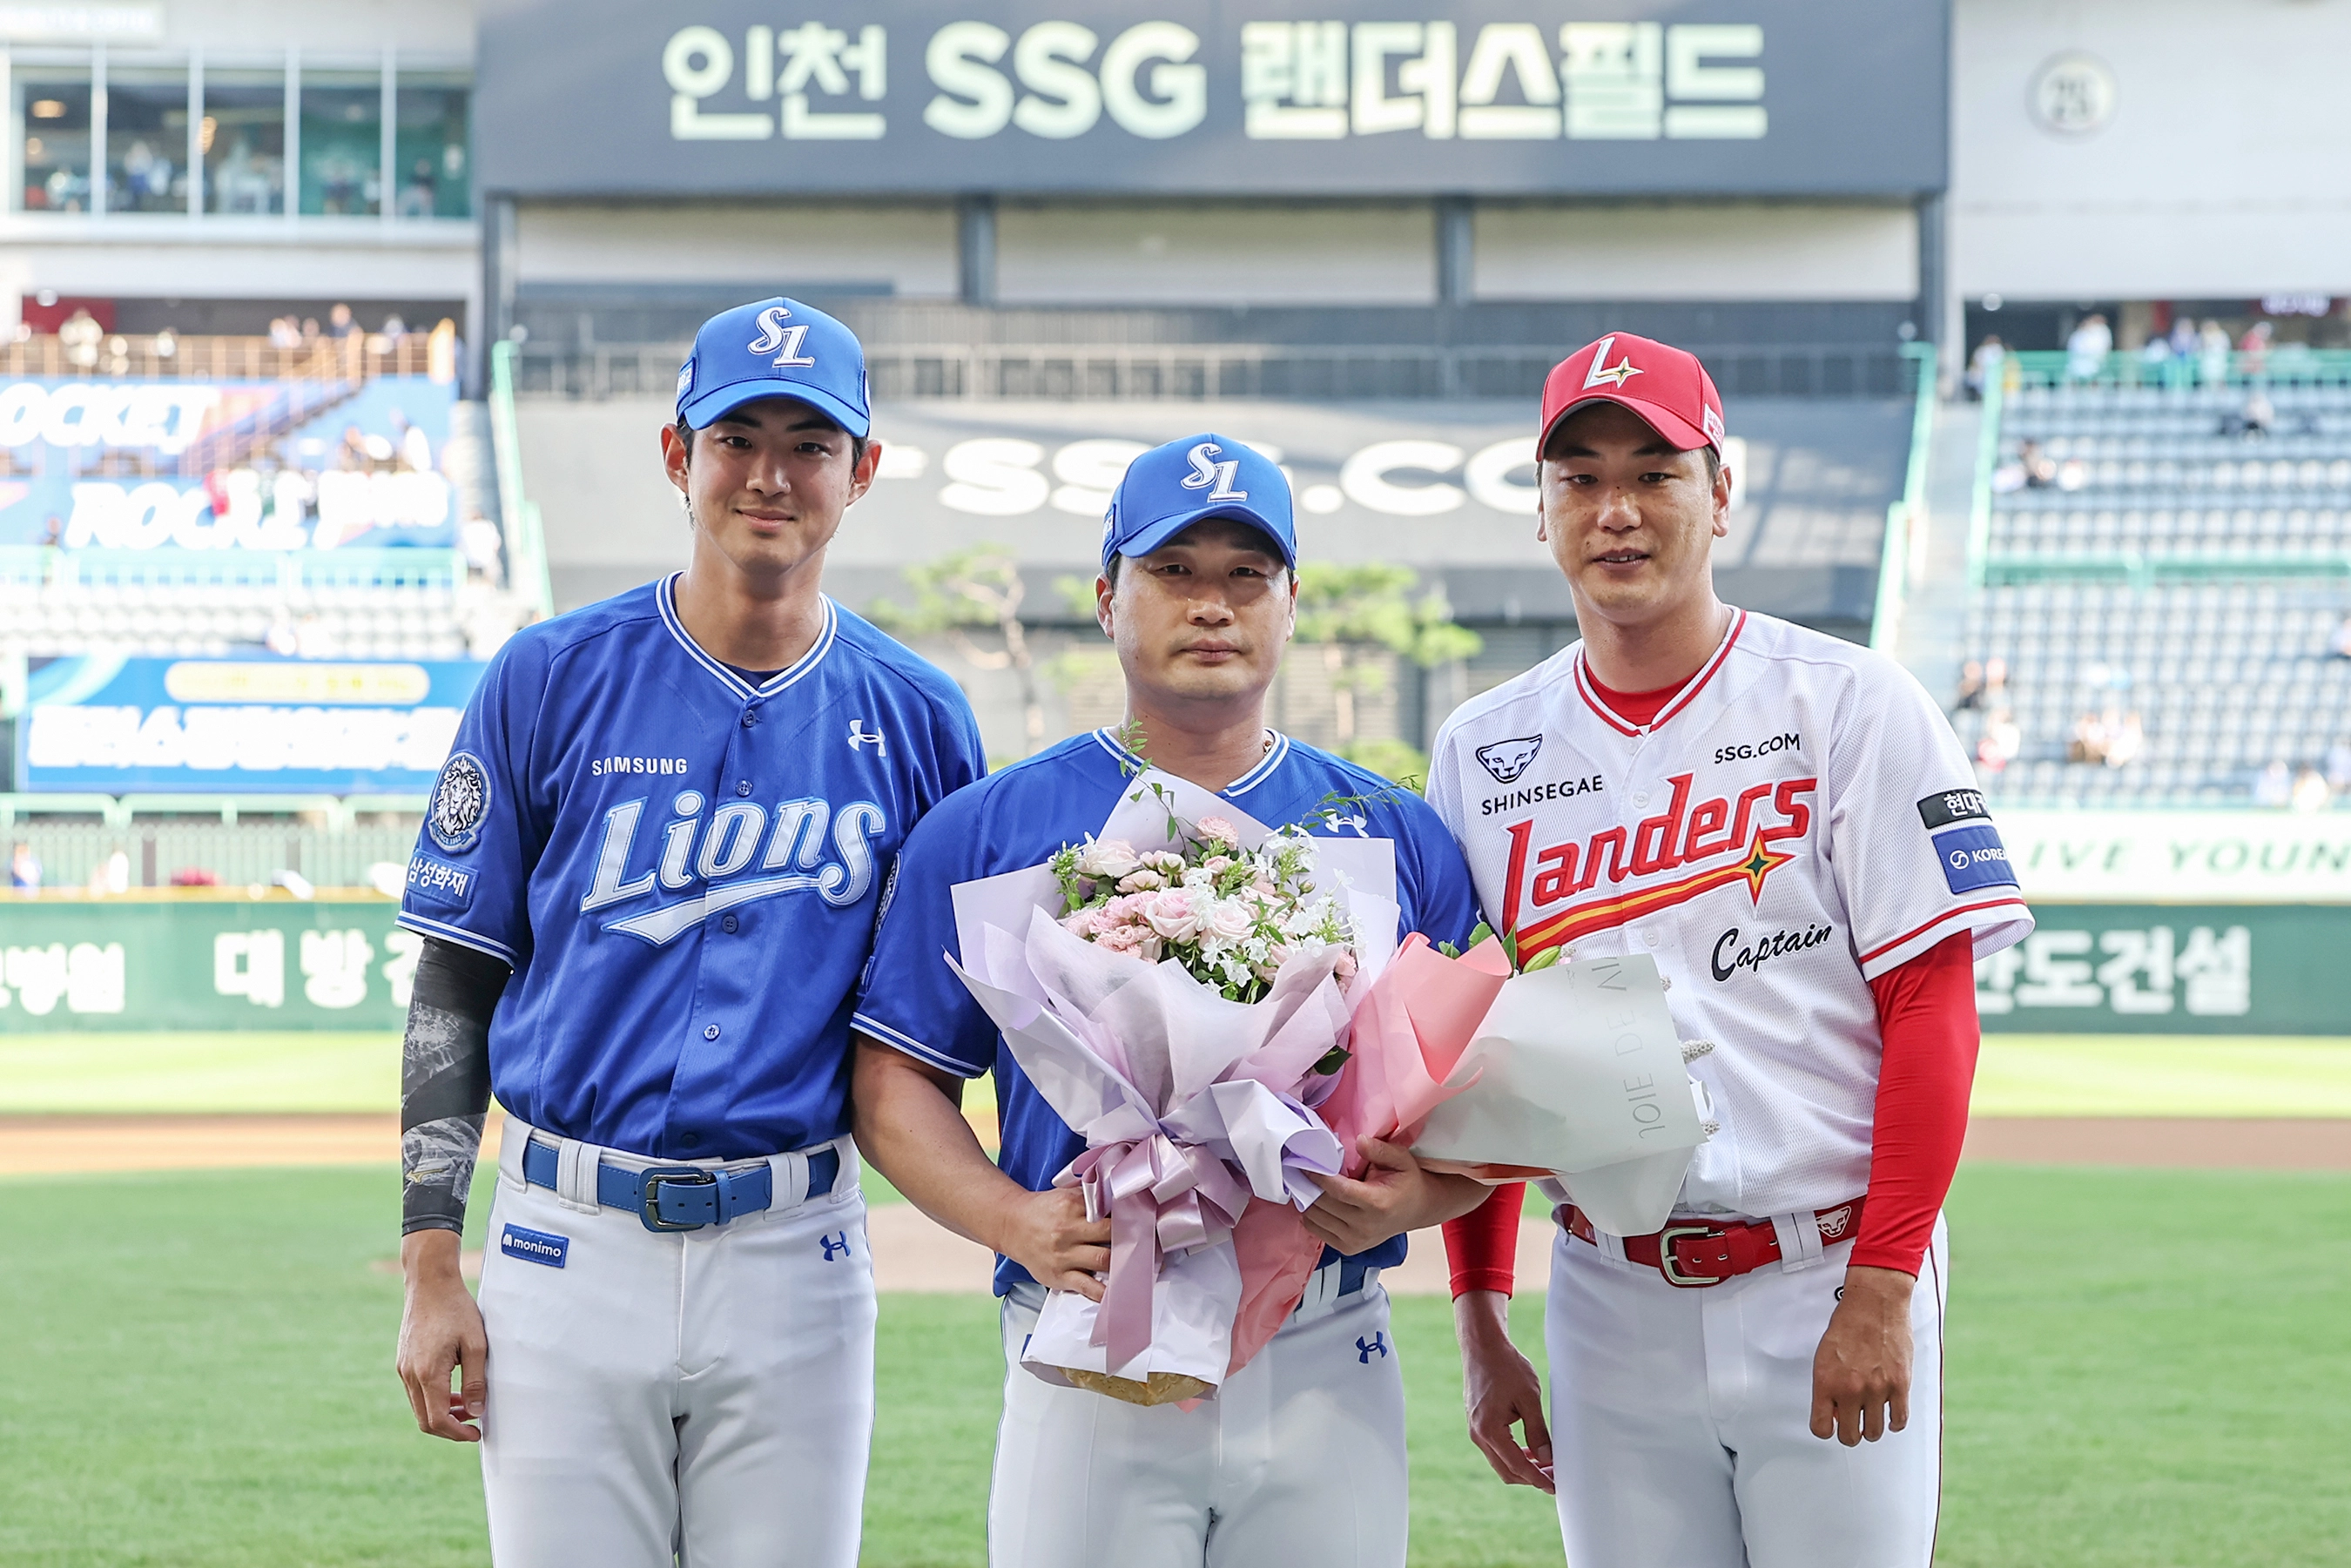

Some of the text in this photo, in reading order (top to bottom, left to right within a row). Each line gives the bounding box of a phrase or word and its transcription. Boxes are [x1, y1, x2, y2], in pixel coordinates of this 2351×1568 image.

[662, 20, 1768, 140] 인천 SSG 랜더스필드
[746, 306, 816, 369] SL
[1180, 442, 1248, 502] SL
[591, 757, 689, 777] SAMSUNG
[1714, 732, 1801, 764] SSG.COM
[1482, 775, 1604, 816] SHINSEGAE
[580, 788, 886, 914] Lions
[408, 857, 469, 898] 삼성화재
[1710, 922, 1832, 982] Captain
[513, 1237, 562, 1257] monimo
